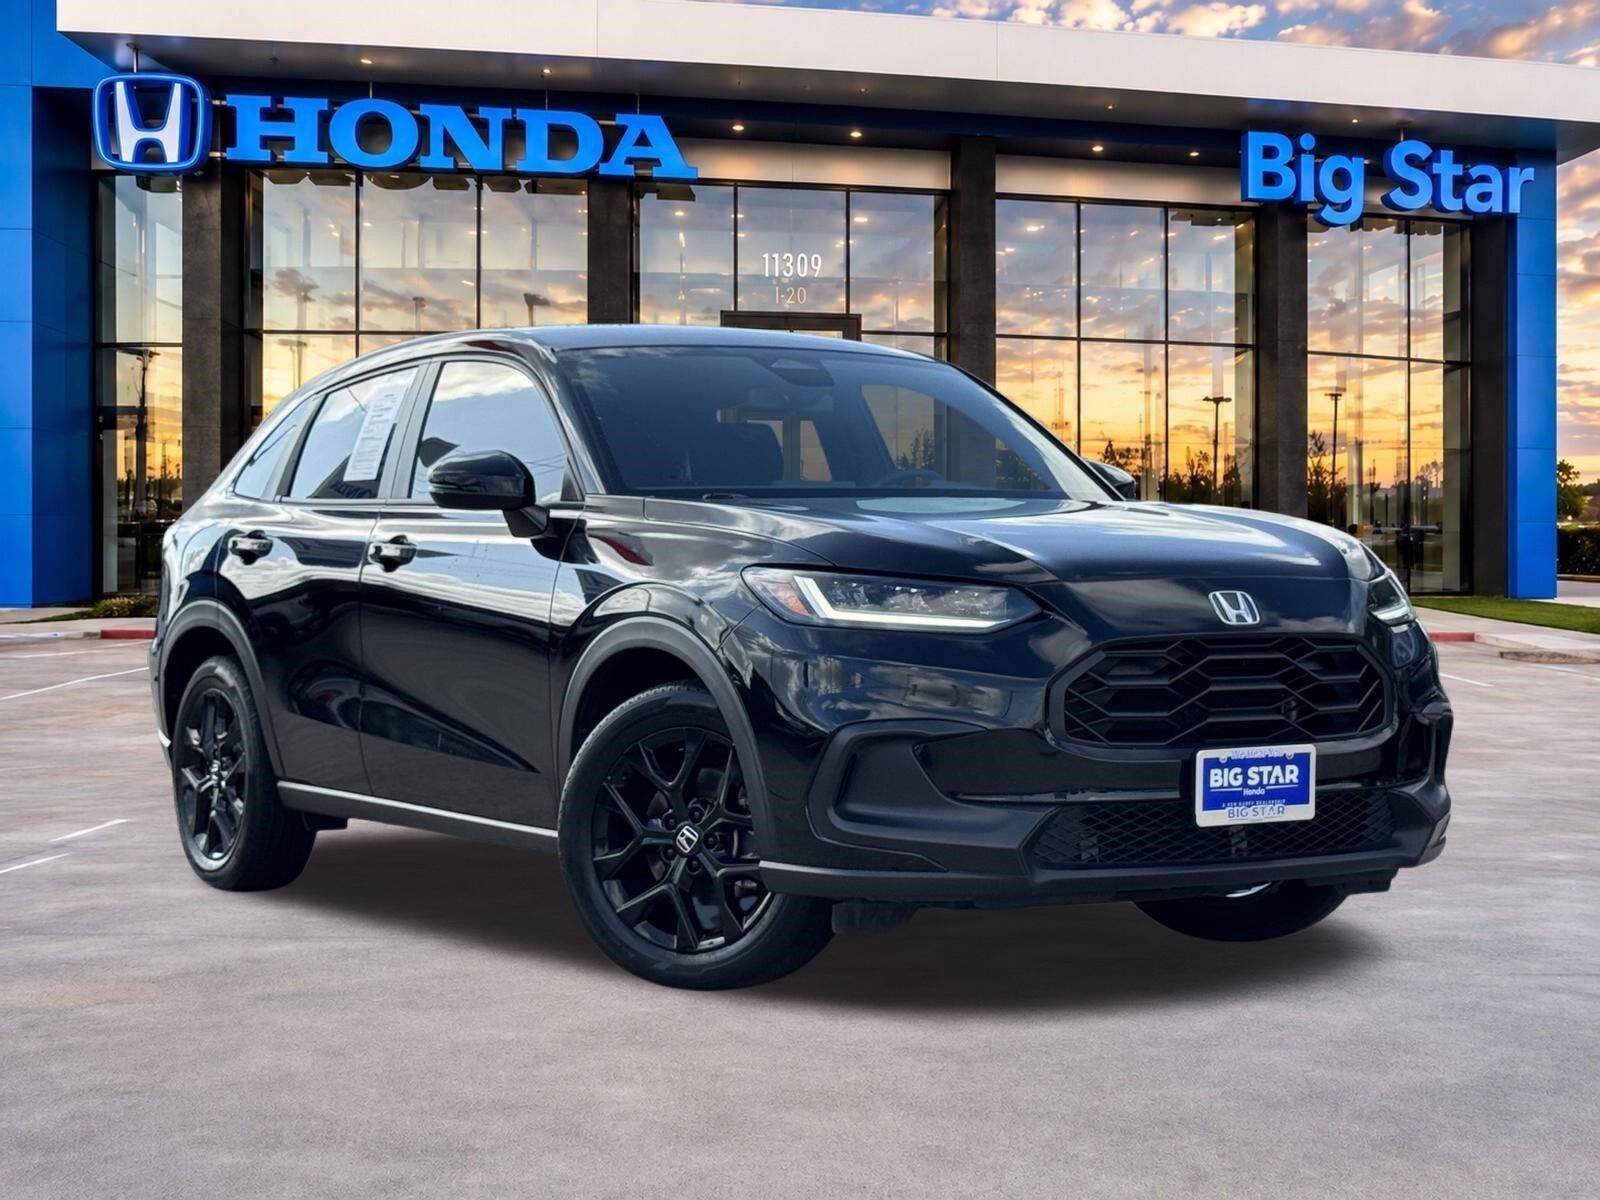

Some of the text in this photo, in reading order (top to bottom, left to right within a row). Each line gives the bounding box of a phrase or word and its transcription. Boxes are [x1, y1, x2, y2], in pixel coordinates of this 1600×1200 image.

[225, 94, 698, 179] HONDA
[1243, 131, 1535, 225] Big Star
[762, 252, 822, 278] 11309
[775, 286, 807, 304] I-20
[1209, 764, 1299, 788] BIG STAR
[1243, 786, 1265, 796] Honda
[1227, 805, 1285, 818] BIG STAR
